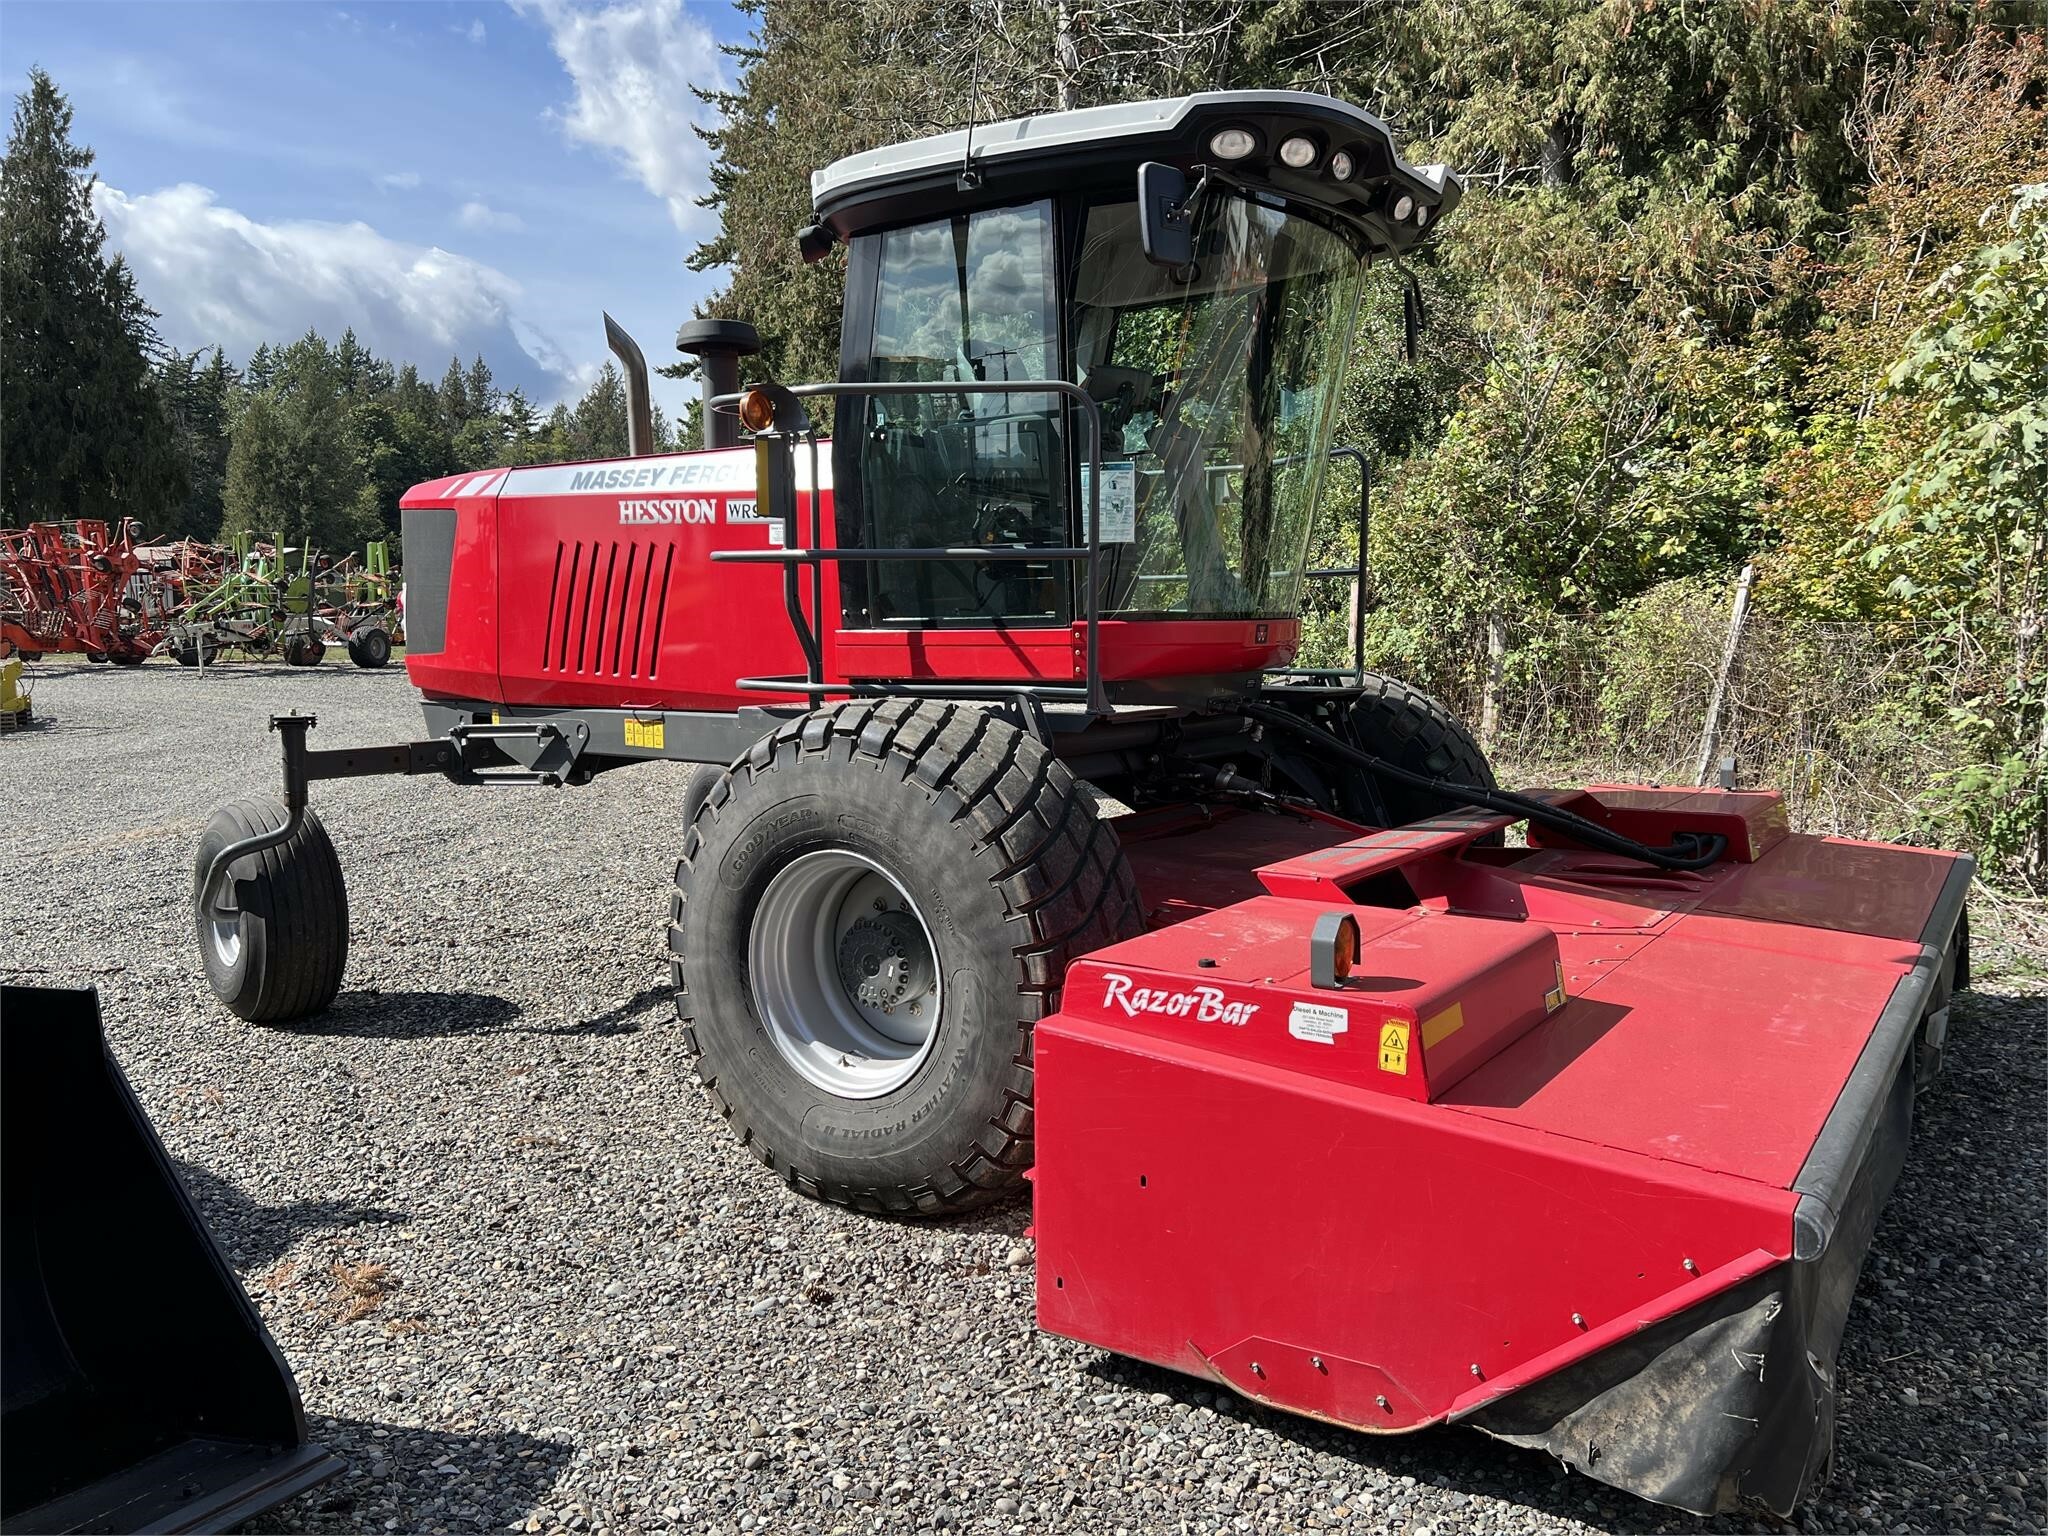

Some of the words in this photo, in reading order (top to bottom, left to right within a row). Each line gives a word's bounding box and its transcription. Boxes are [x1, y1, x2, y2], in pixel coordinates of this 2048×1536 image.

[570, 467, 666, 490] MASSEY
[618, 498, 718, 524] HESSTON
[1102, 972, 1261, 1027] RazorBar
[911, 1048, 967, 1123] WEATHER
[842, 1121, 907, 1139] RADIAL
